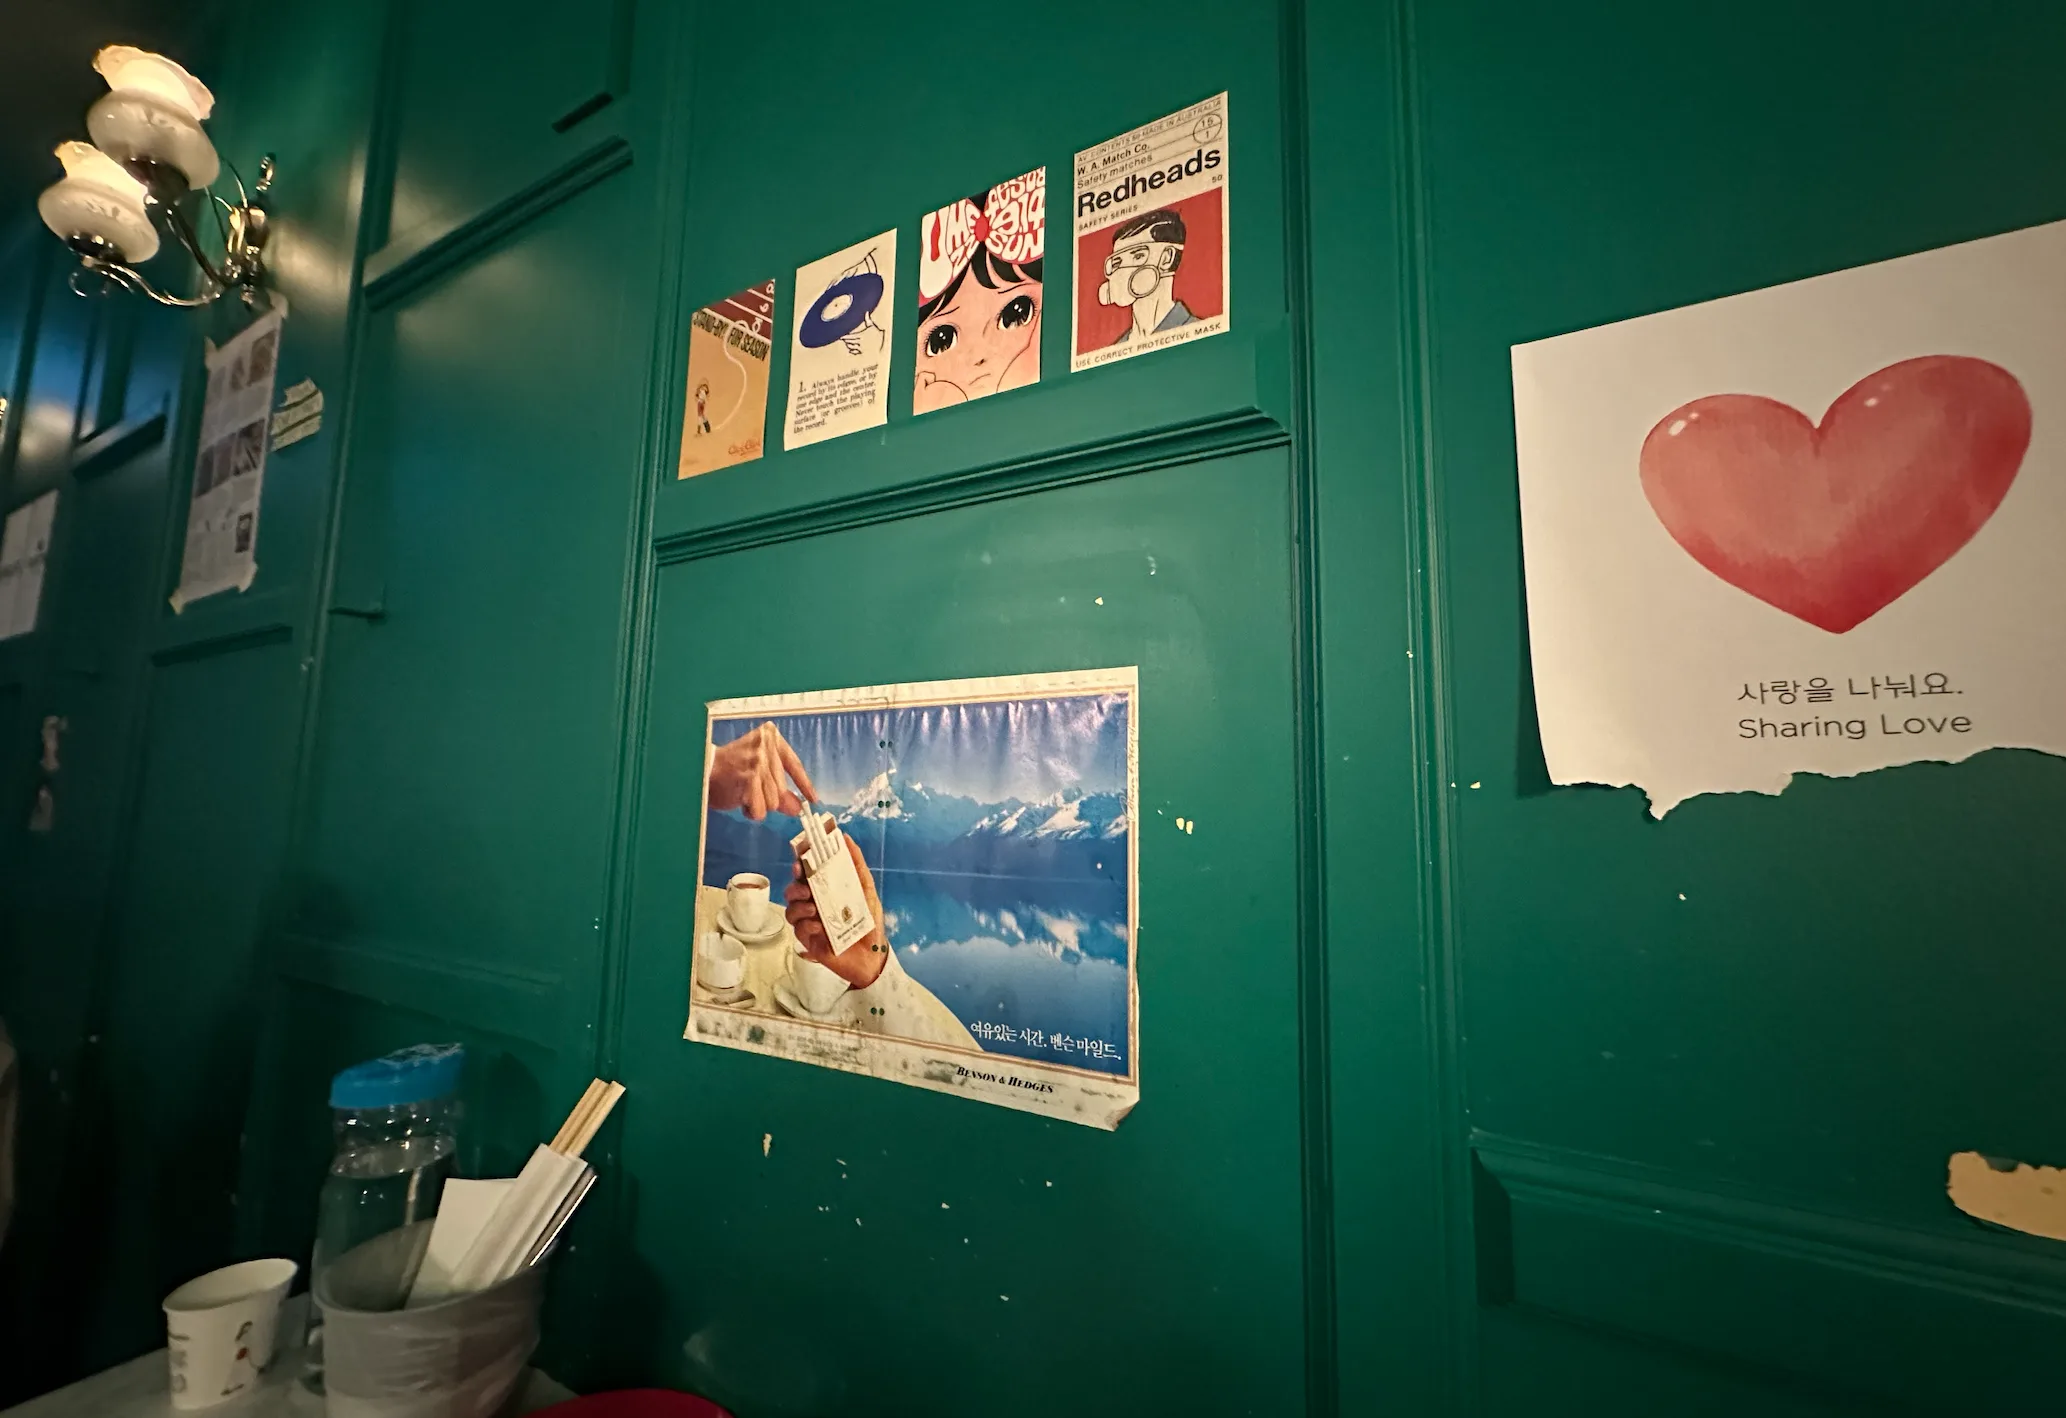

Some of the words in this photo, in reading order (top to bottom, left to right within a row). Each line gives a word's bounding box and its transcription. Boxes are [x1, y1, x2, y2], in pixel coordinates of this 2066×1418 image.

[1102, 149, 1131, 166] Match
[1134, 143, 1150, 153] Co.
[1077, 172, 1107, 189] Safety
[1109, 153, 1153, 177] matches
[1077, 148, 1221, 218] Redheads
[1078, 215, 1108, 231] SAFETY
[1110, 204, 1138, 220] SERIES
[1075, 357, 1092, 368] USE
[1094, 346, 1133, 363] CORRECT
[1136, 331, 1190, 351] PROTECTIVE
[1194, 322, 1222, 337] MASK
[798, 381, 807, 393] 1.
[795, 407, 814, 418] Never
[850, 389, 876, 403] playing
[1737, 677, 1835, 705] 사랑을
[1848, 672, 1963, 700] 나눠요.
[1738, 715, 1866, 740] Sharing
[1880, 713, 1973, 735] Love
[970, 1020, 1017, 1043] 여유있는
[1019, 1027, 1048, 1048] 시간.
[1050, 1032, 1075, 1053] 벤슨
[1076, 1038, 1122, 1061] 마일드.
[956, 1066, 997, 1083] BENSON
[998, 1076, 1005, 1084] &
[1007, 1076, 1054, 1094] HEDGES
